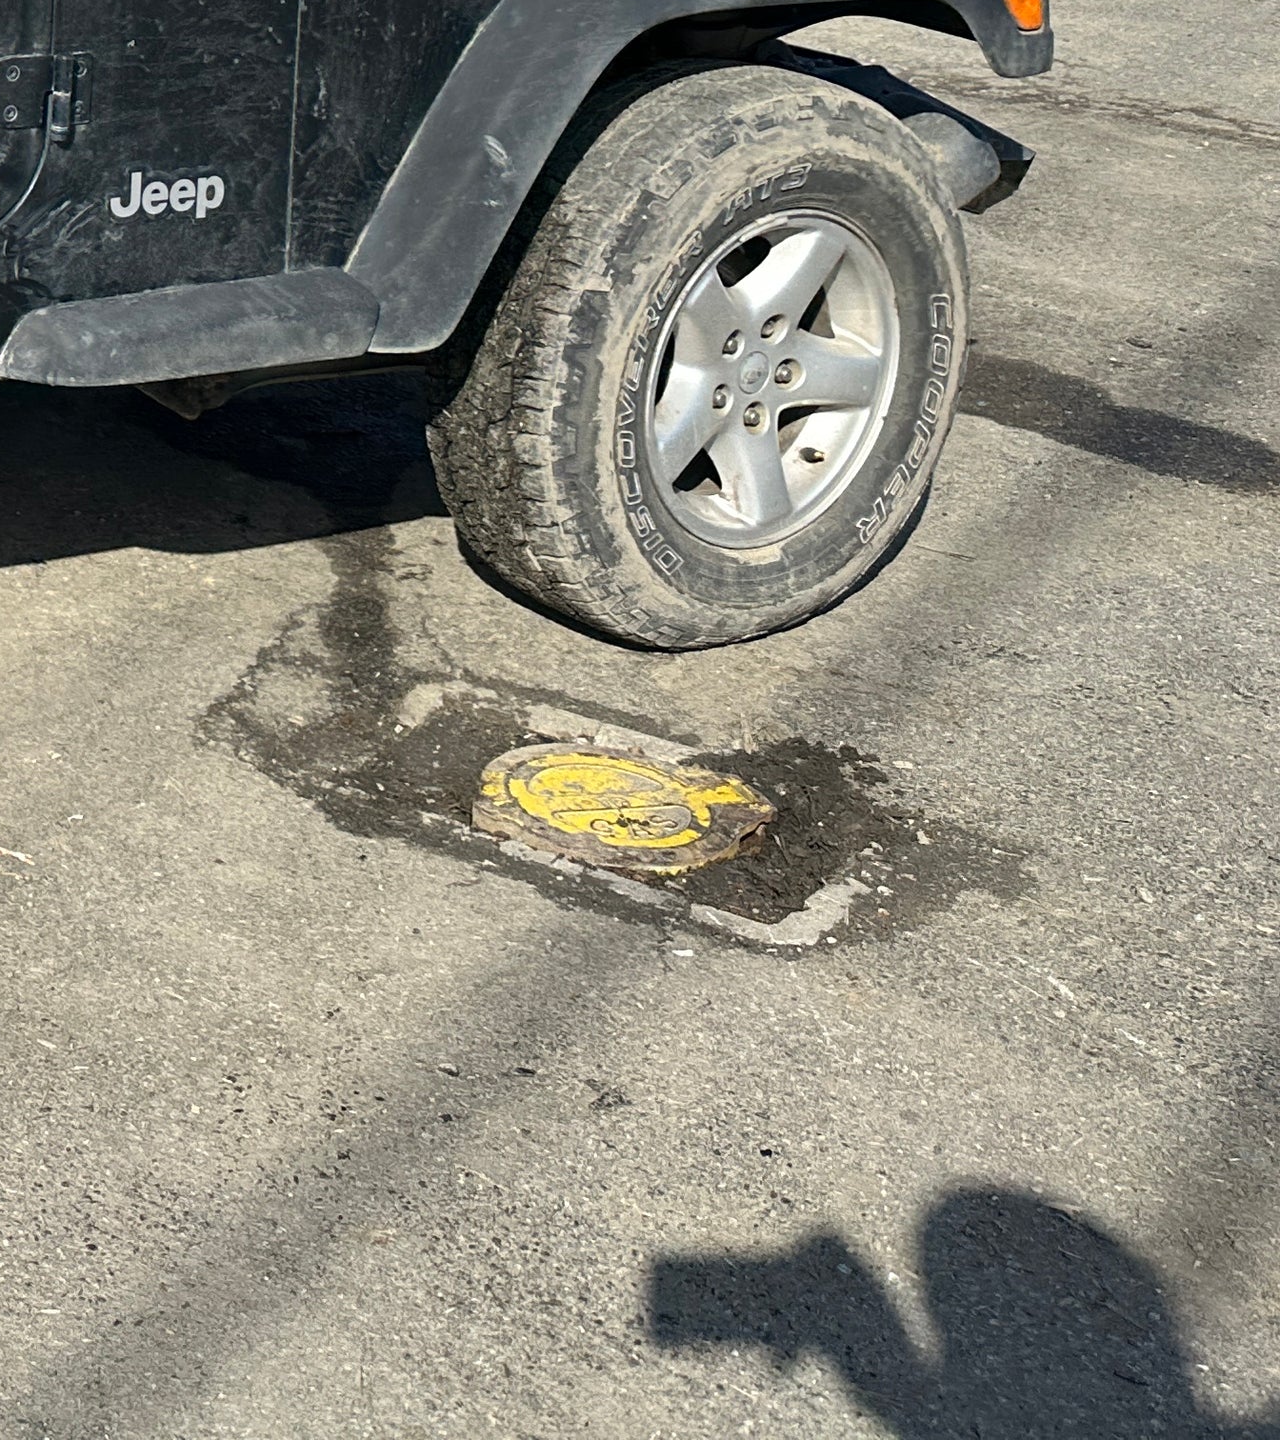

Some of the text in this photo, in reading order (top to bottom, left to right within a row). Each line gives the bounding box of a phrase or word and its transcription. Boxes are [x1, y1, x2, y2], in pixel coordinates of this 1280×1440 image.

[110, 171, 225, 219] Jeep
[617, 162, 812, 575] DISCOVERER AT3
[856, 293, 953, 544] COOPER
